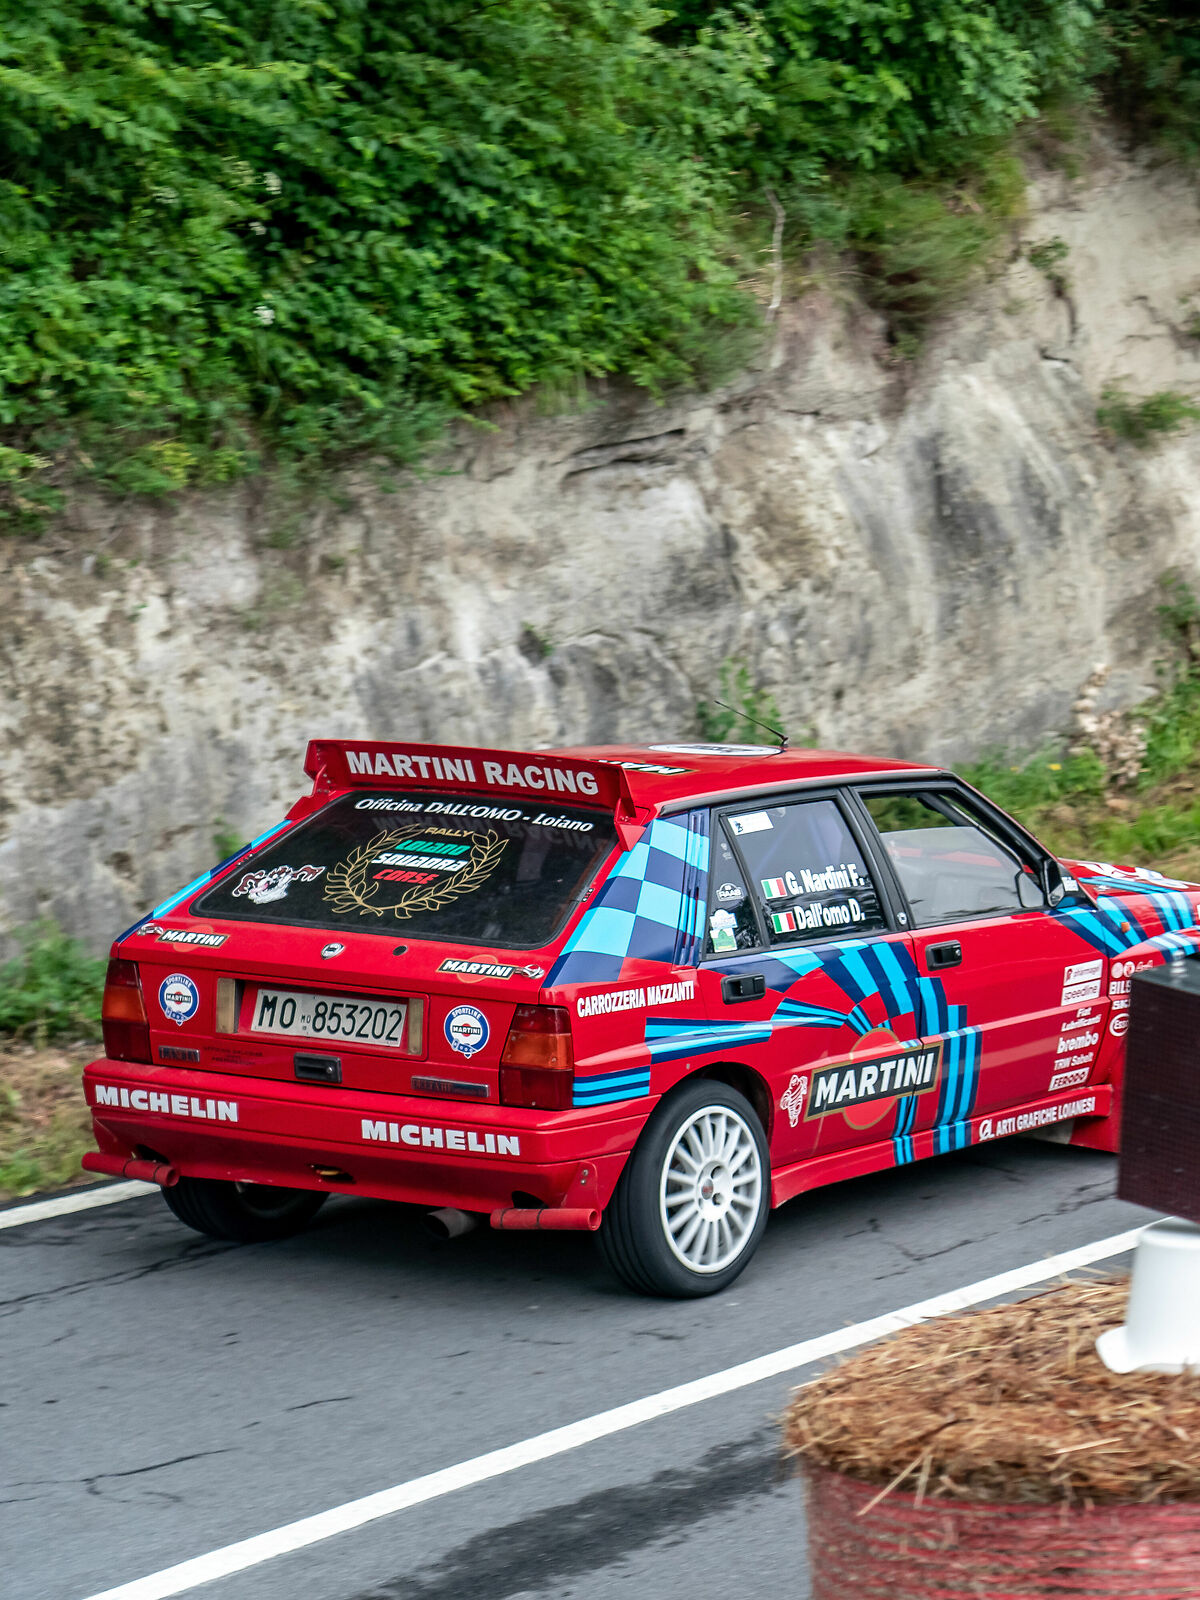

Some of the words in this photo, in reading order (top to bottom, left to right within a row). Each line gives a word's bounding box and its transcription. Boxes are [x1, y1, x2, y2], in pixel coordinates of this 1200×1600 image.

[345, 751, 476, 783] MARTINI
[483, 761, 599, 795] RACING
[354, 799, 423, 813] Officina
[424, 802, 523, 821] DALL'OMO
[531, 813, 594, 832] Loiano
[424, 826, 474, 838] RALLY
[372, 869, 440, 885] CORSE
[785, 870, 803, 896] G.
[800, 864, 850, 892] Nardini
[849, 863, 865, 887] F.
[794, 902, 850, 929] Dall'omo
[848, 898, 866, 922] D.
[162, 930, 226, 946] MARTINI
[442, 960, 514, 977] MARTINI
[166, 976, 192, 988] SPORTLINE
[1109, 980, 1131, 995] BILS
[166, 993, 191, 1003] MARTINI
[577, 988, 646, 1017] CARROZZERIA
[646, 980, 695, 1006] MAZZANTI
[1063, 983, 1098, 1001] speedline
[258, 996, 297, 1028] MO
[312, 1001, 402, 1042] 853202
[452, 1008, 481, 1020] SPORTLINE
[452, 1026, 480, 1035] MARTINI
[1113, 1018, 1129, 1030] Ess
[1056, 1031, 1099, 1054] brembo
[814, 1052, 934, 1108] MARTINI
[1052, 1070, 1086, 1089] FERODO
[95, 1085, 238, 1122] MICHELIN
[996, 1119, 1016, 1137] ARTI
[1016, 1109, 1057, 1132] GRAFICHE
[1058, 1096, 1096, 1123] LOIANESI
[361, 1119, 520, 1156] MICHELIN
